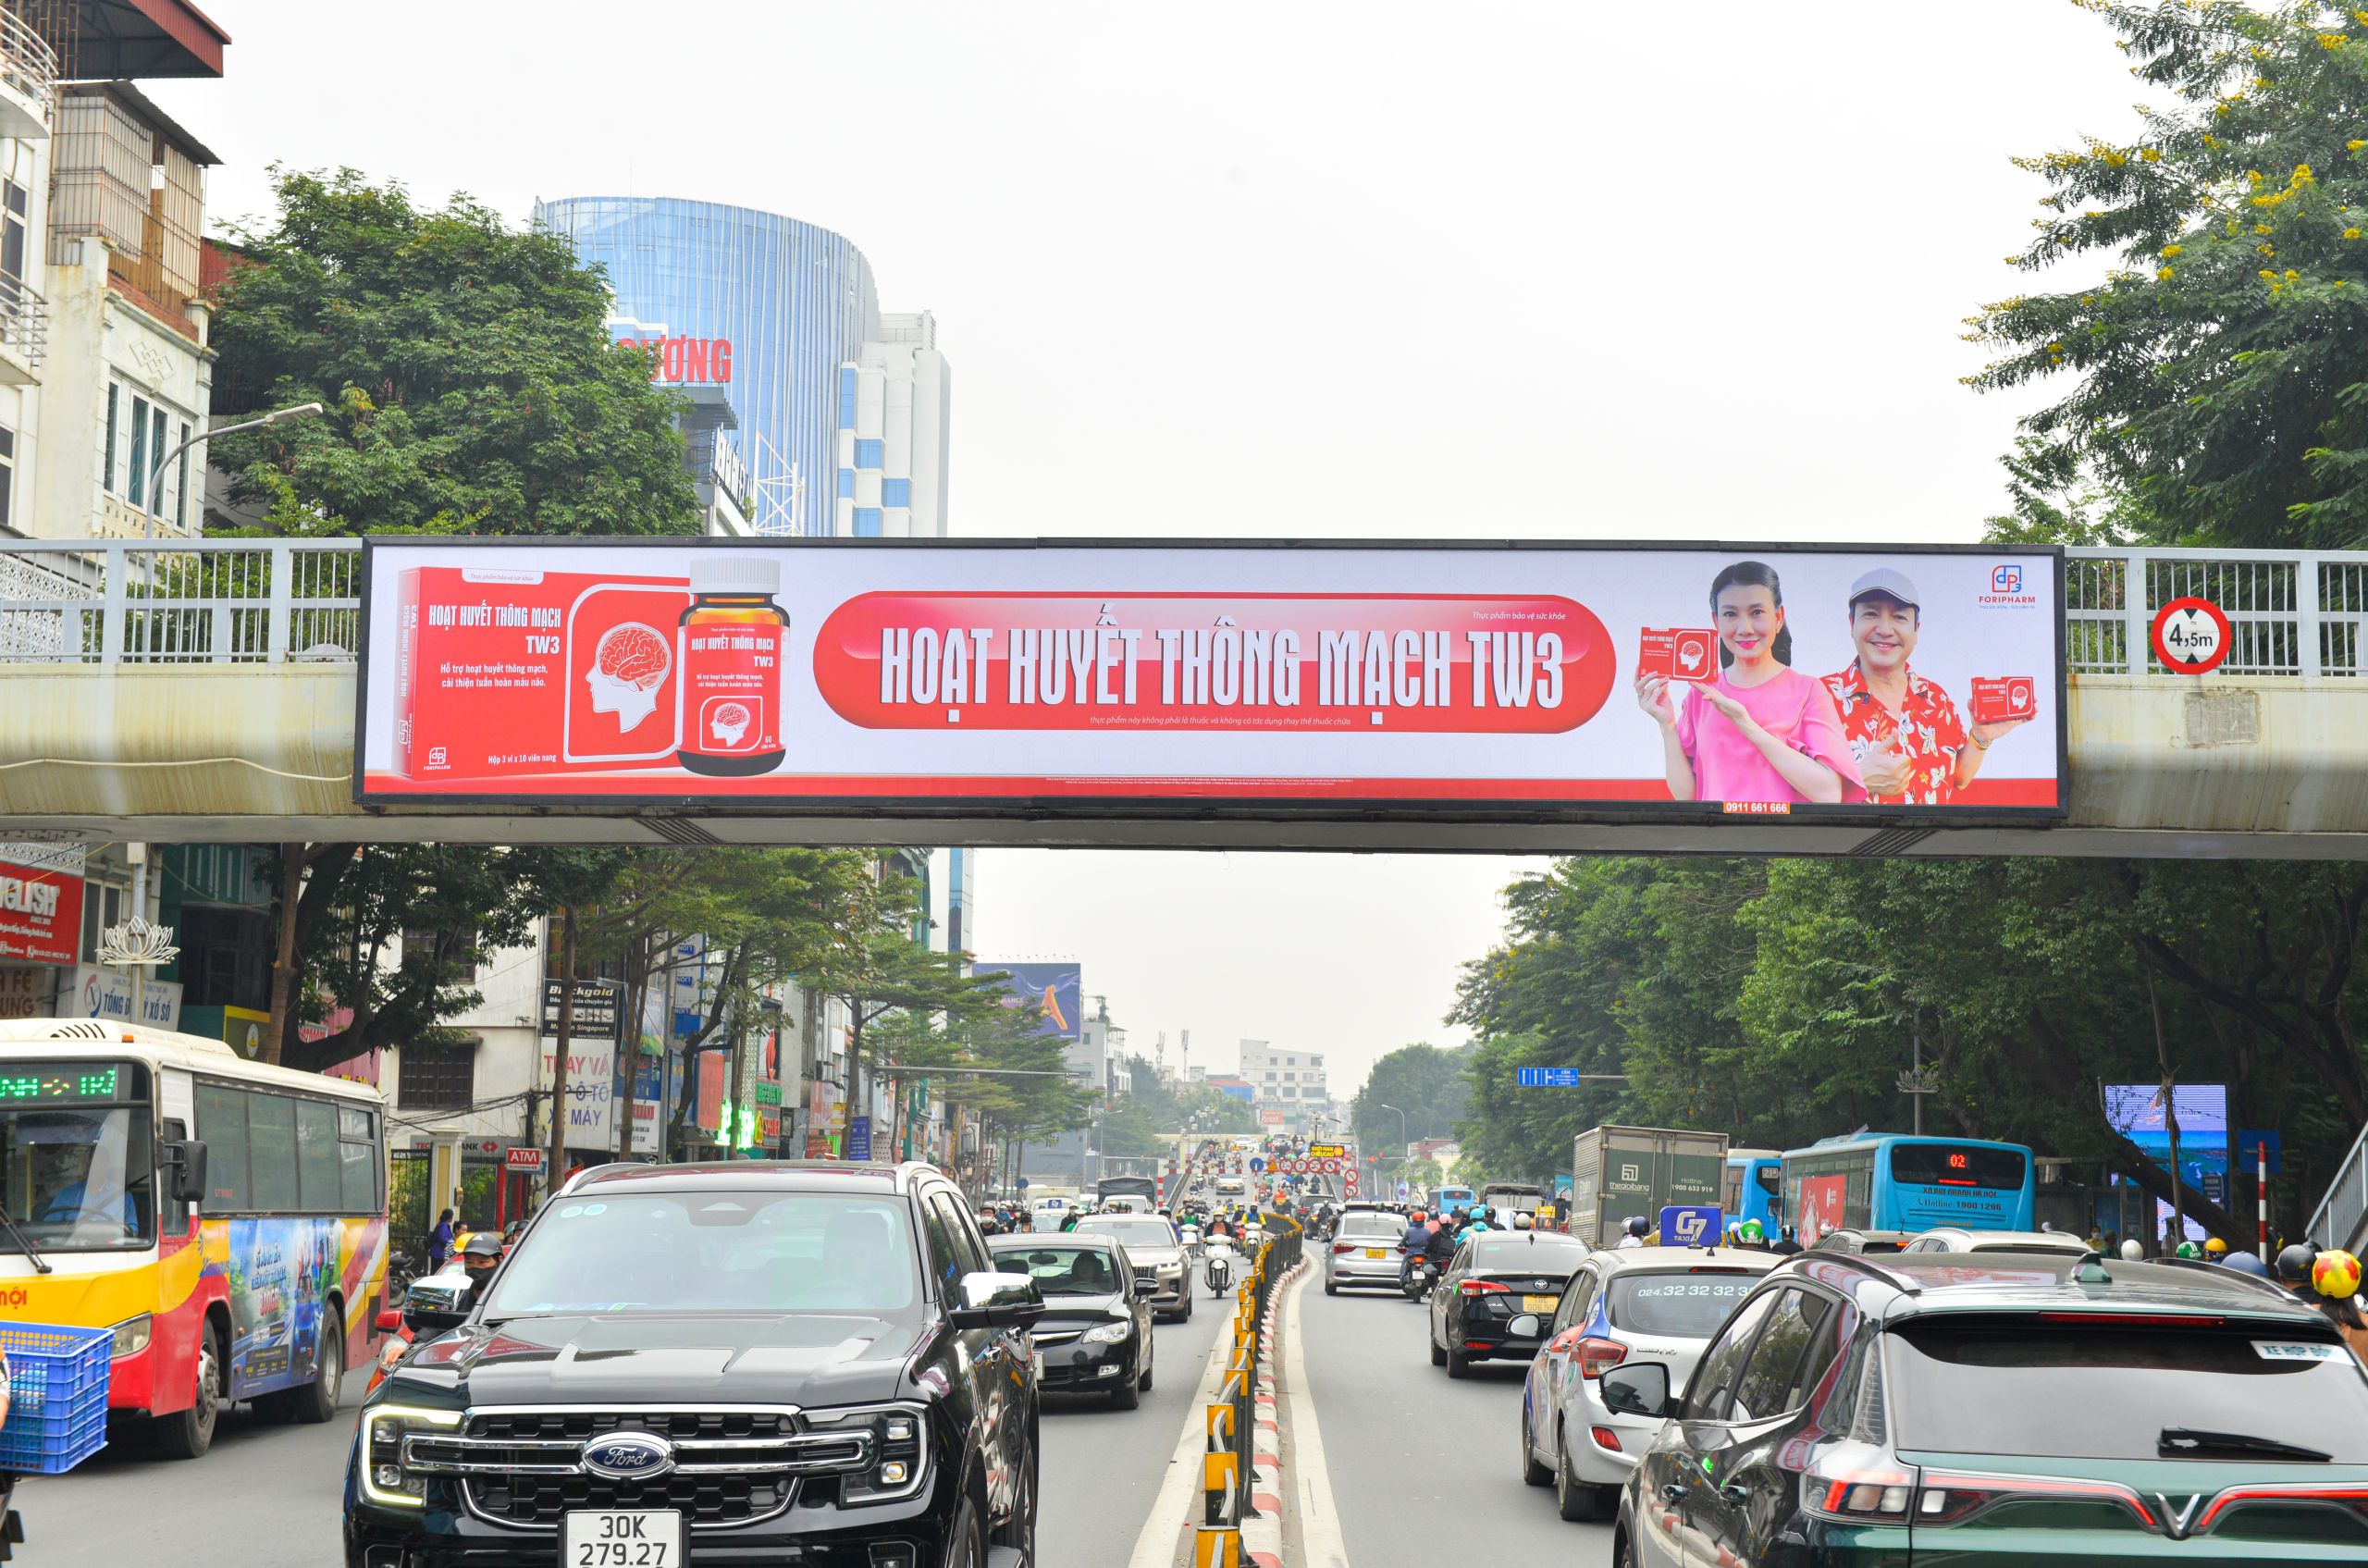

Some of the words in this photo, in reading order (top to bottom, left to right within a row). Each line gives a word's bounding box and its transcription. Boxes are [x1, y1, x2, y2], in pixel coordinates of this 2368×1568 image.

[428, 604, 457, 631] HOẠT
[460, 599, 492, 627] HUYẾT
[495, 603, 528, 627] THÔNG
[531, 608, 561, 632] MẠCH
[1473, 611, 1489, 621] Thực
[1490, 611, 1511, 621] phẩm
[1511, 611, 1525, 620] bảo
[1526, 613, 1535, 622] vệ
[2169, 623, 2213, 648] 4,5m
[525, 636, 561, 655] TW3
[691, 637, 707, 653] HOẠT
[708, 634, 730, 650] HUYẾT
[731, 635, 755, 650] THÔNG
[756, 637, 774, 653] MẠCH
[440, 661, 450, 673] Hỗ
[452, 664, 464, 675] trợ
[465, 664, 482, 675] hoạt
[484, 661, 504, 675] huyết
[505, 664, 525, 675] thông
[527, 664, 549, 675] mạch,
[753, 655, 774, 668] TW3
[879, 627, 993, 722] HOẠT
[1007, 602, 1143, 705] HUYẾT
[1156, 615, 1300, 707] THÔNG
[1317, 629, 1451, 725] MẠCH
[1466, 631, 1564, 709] TW3
[441, 677, 453, 687] cải
[455, 678, 475, 689] thiện
[475, 675, 492, 687] tuần
[494, 678, 512, 687] hoàn
[513, 678, 529, 687] máu
[531, 678, 546, 687] não.
[1090, 716, 1105, 725] thực
[1106, 715, 1128, 725] phẩm
[1128, 716, 1141, 725] này
[1142, 716, 1164, 725] không
[1165, 716, 1181, 725] phải
[1181, 716, 1189, 724] là
[1190, 716, 1209, 724] thuốc
[1220, 717, 1242, 726] không
[1243, 717, 1252, 725] có
[1252, 717, 1264, 725] tác
[1264, 717, 1283, 727] dụng
[1284, 717, 1299, 726] thay
[1300, 716, 1312, 725] thế
[1313, 717, 1333, 725] thuốc
[1333, 717, 1351, 725] chữa
[765, 735, 772, 744] 60
[487, 755, 500, 766] Hộp
[502, 755, 506, 763] 3
[519, 755, 527, 763] 10
[527, 754, 540, 762] viên
[541, 755, 557, 763] nang
[1726, 802, 1748, 812] 0911
[1750, 803, 1768, 812] 661
[1770, 803, 1787, 813] 666
[549, 985, 614, 998] Blkgold
[104, 987, 124, 1016] TỔNG
[149, 995, 161, 1020] XỔ
[160, 998, 173, 1022] SỐ
[576, 1024, 610, 1032] Singapore
[588, 1053, 610, 1076] VÁ
[575, 1080, 586, 1102] Ô
[589, 1081, 610, 1103] TÔ
[570, 1105, 602, 1127] MÁY
[510, 1151, 537, 1163] ATM
[1949, 1154, 1966, 1168] 02
[1681, 1177, 1704, 1185] Hotline:
[1956, 1201, 1978, 1209] 1900
[1980, 1203, 2002, 1211] 1296
[1675, 1211, 1708, 1241] G7
[1688, 1286, 1710, 1296] 32
[1713, 1286, 1734, 1296] 32
[1527, 1303, 1555, 1312] 006.90
[2262, 1345, 2281, 1355] XE
[2281, 1345, 2306, 1359] HỢP
[603, 1446, 648, 1466] Ford
[599, 1515, 647, 1538] 30K
[579, 1542, 667, 1566] 279.27
